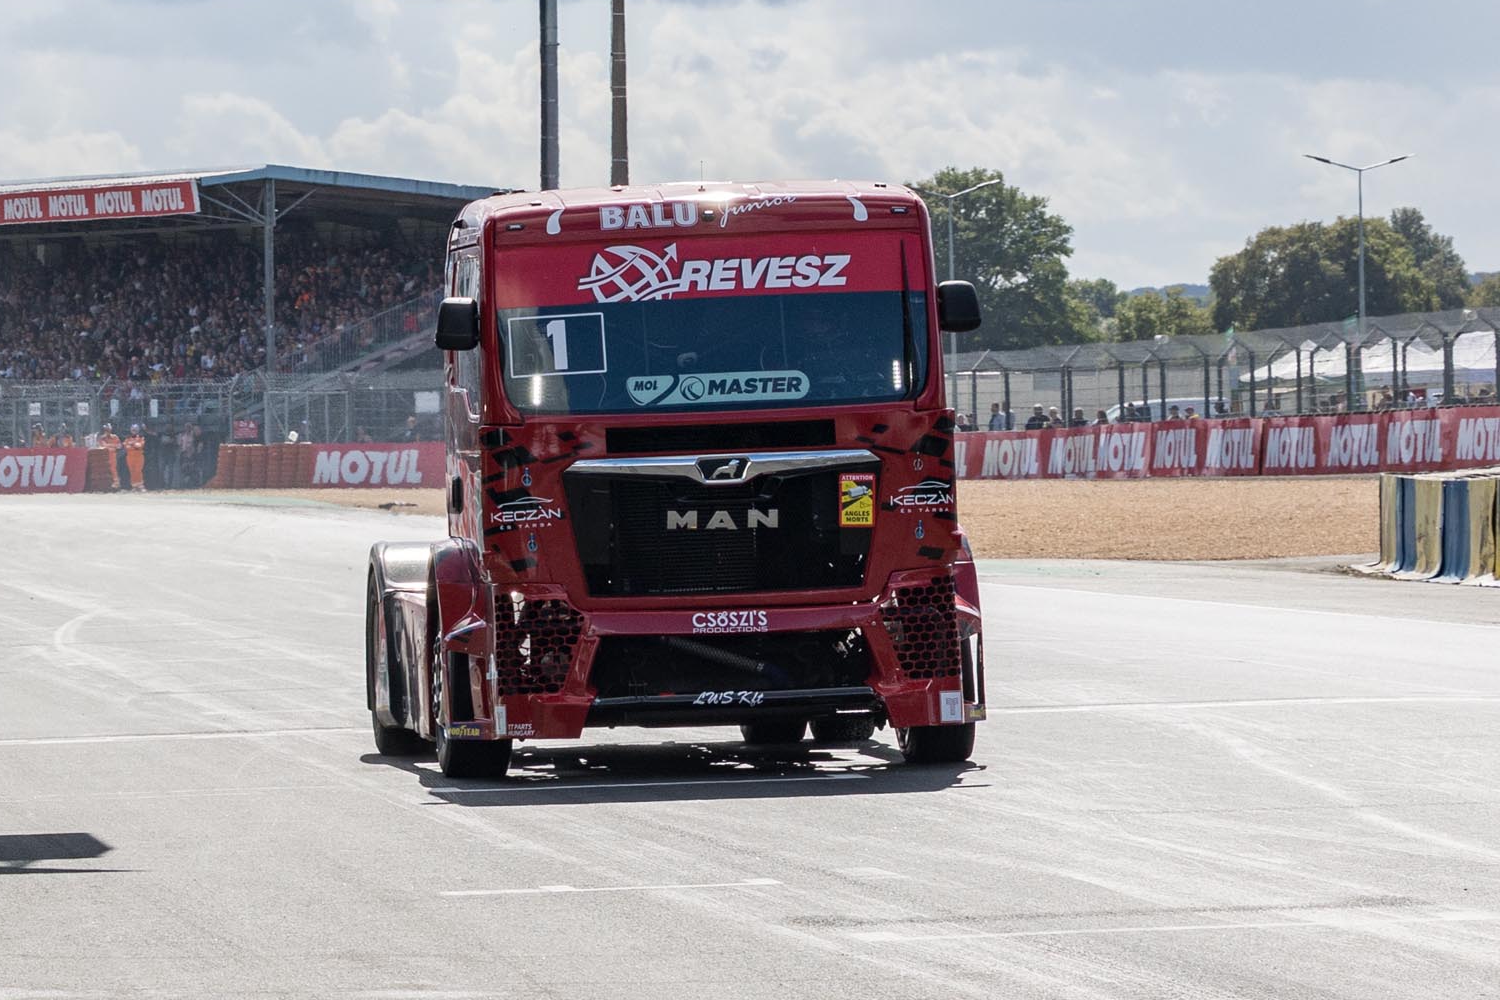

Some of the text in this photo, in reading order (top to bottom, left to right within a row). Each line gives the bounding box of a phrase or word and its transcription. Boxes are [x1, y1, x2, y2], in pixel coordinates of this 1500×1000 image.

[4, 197, 43, 220] MOTUL
[48, 194, 89, 217] MOTUL
[95, 190, 135, 215] MOTUL
[141, 187, 185, 212] MOTUL
[600, 201, 699, 231] BALU
[546, 319, 569, 370] 1
[633, 380, 659, 392] MOL
[707, 376, 802, 396] MASTER
[981, 438, 1040, 476] MOTUL
[1048, 434, 1097, 475] MOTUL
[1098, 432, 1145, 471] MOTUL
[1153, 428, 1198, 469] MOTUL
[1205, 427, 1255, 469] MOTUL
[1265, 426, 1317, 468] MOTUL
[1327, 423, 1380, 467] MOTUL
[1386, 419, 1443, 464] MOTUL
[1456, 417, 1500, 460] MOTU
[313, 450, 423, 485] MOTUL
[666, 508, 779, 530] MAN
